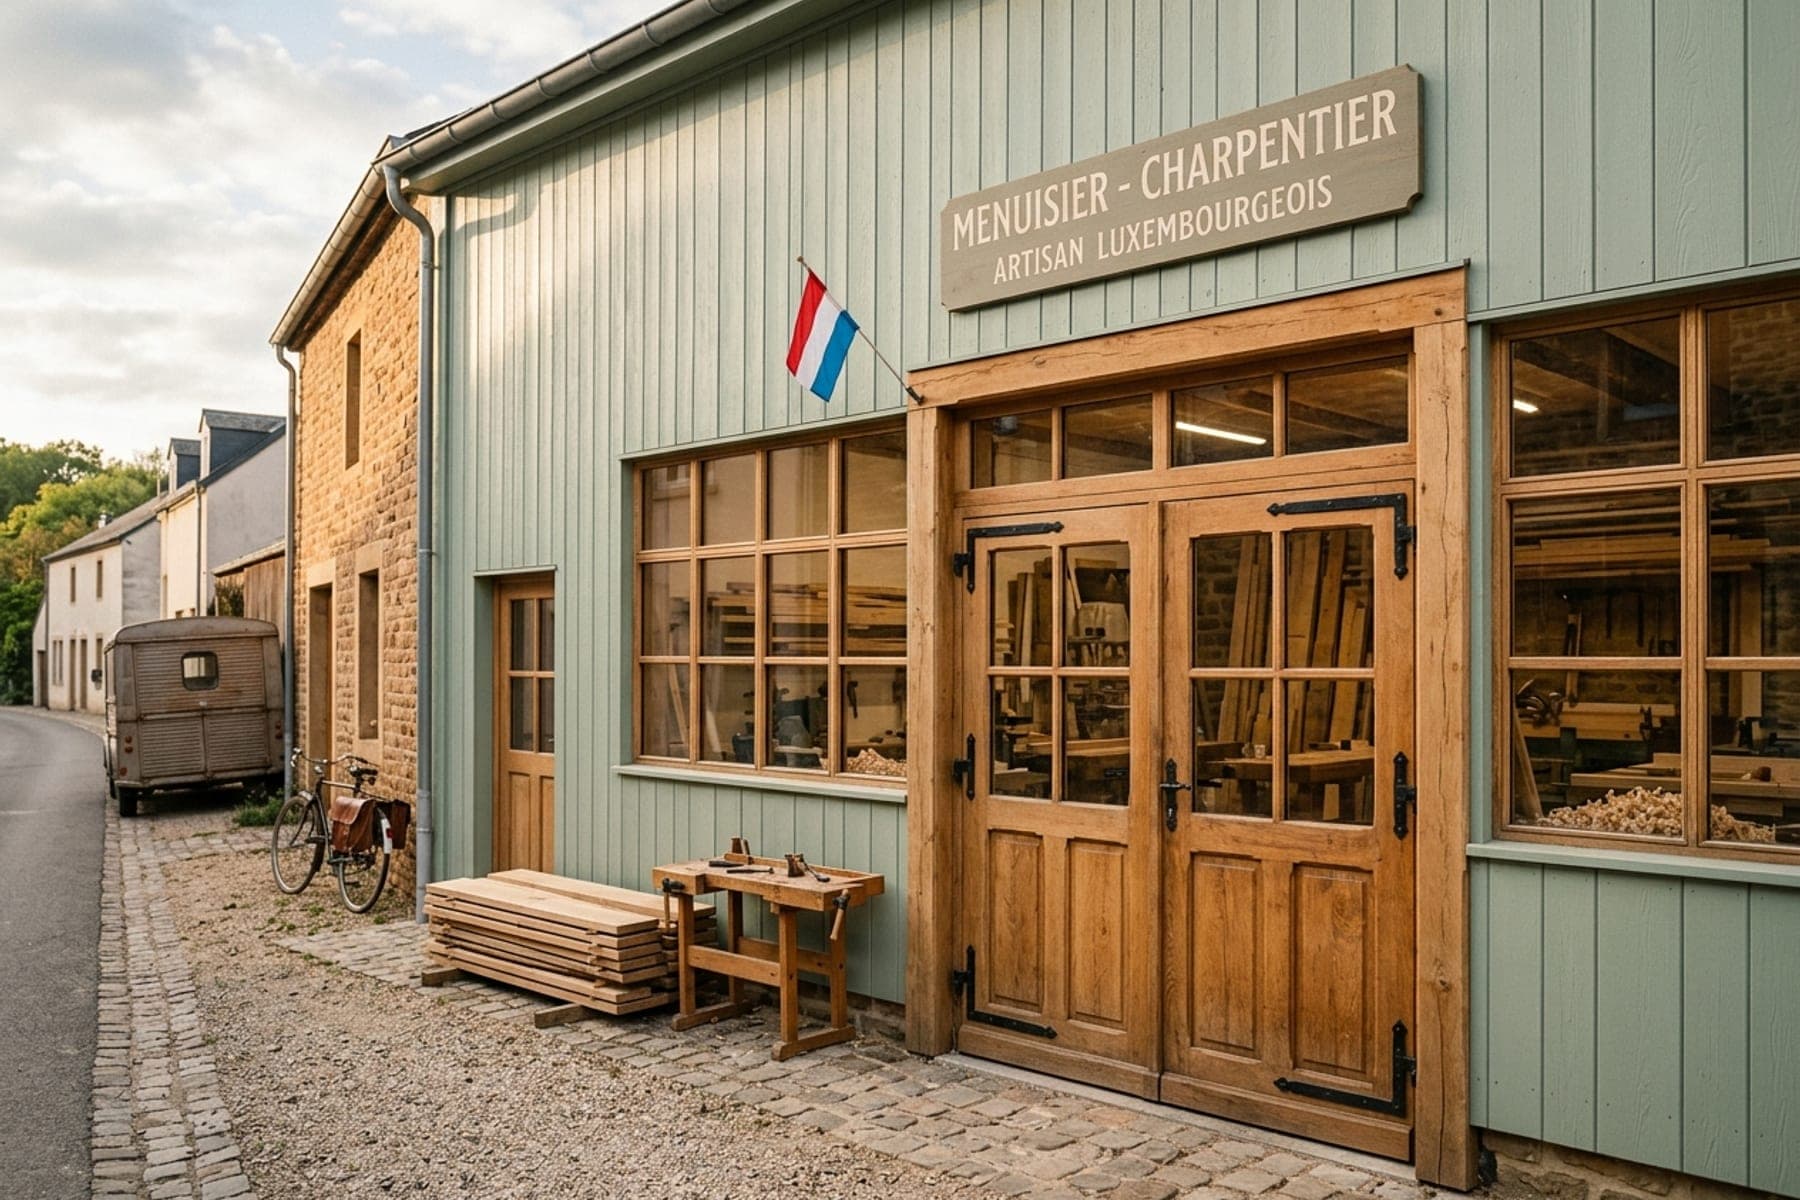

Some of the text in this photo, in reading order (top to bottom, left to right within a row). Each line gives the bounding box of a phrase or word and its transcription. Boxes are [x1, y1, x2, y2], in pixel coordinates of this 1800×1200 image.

[952, 171, 1109, 251] MENUISIER
[1141, 88, 1397, 200] CHARPENTIER
[993, 174, 1333, 285] ARTISAN LUXEMBOURGEOIS
